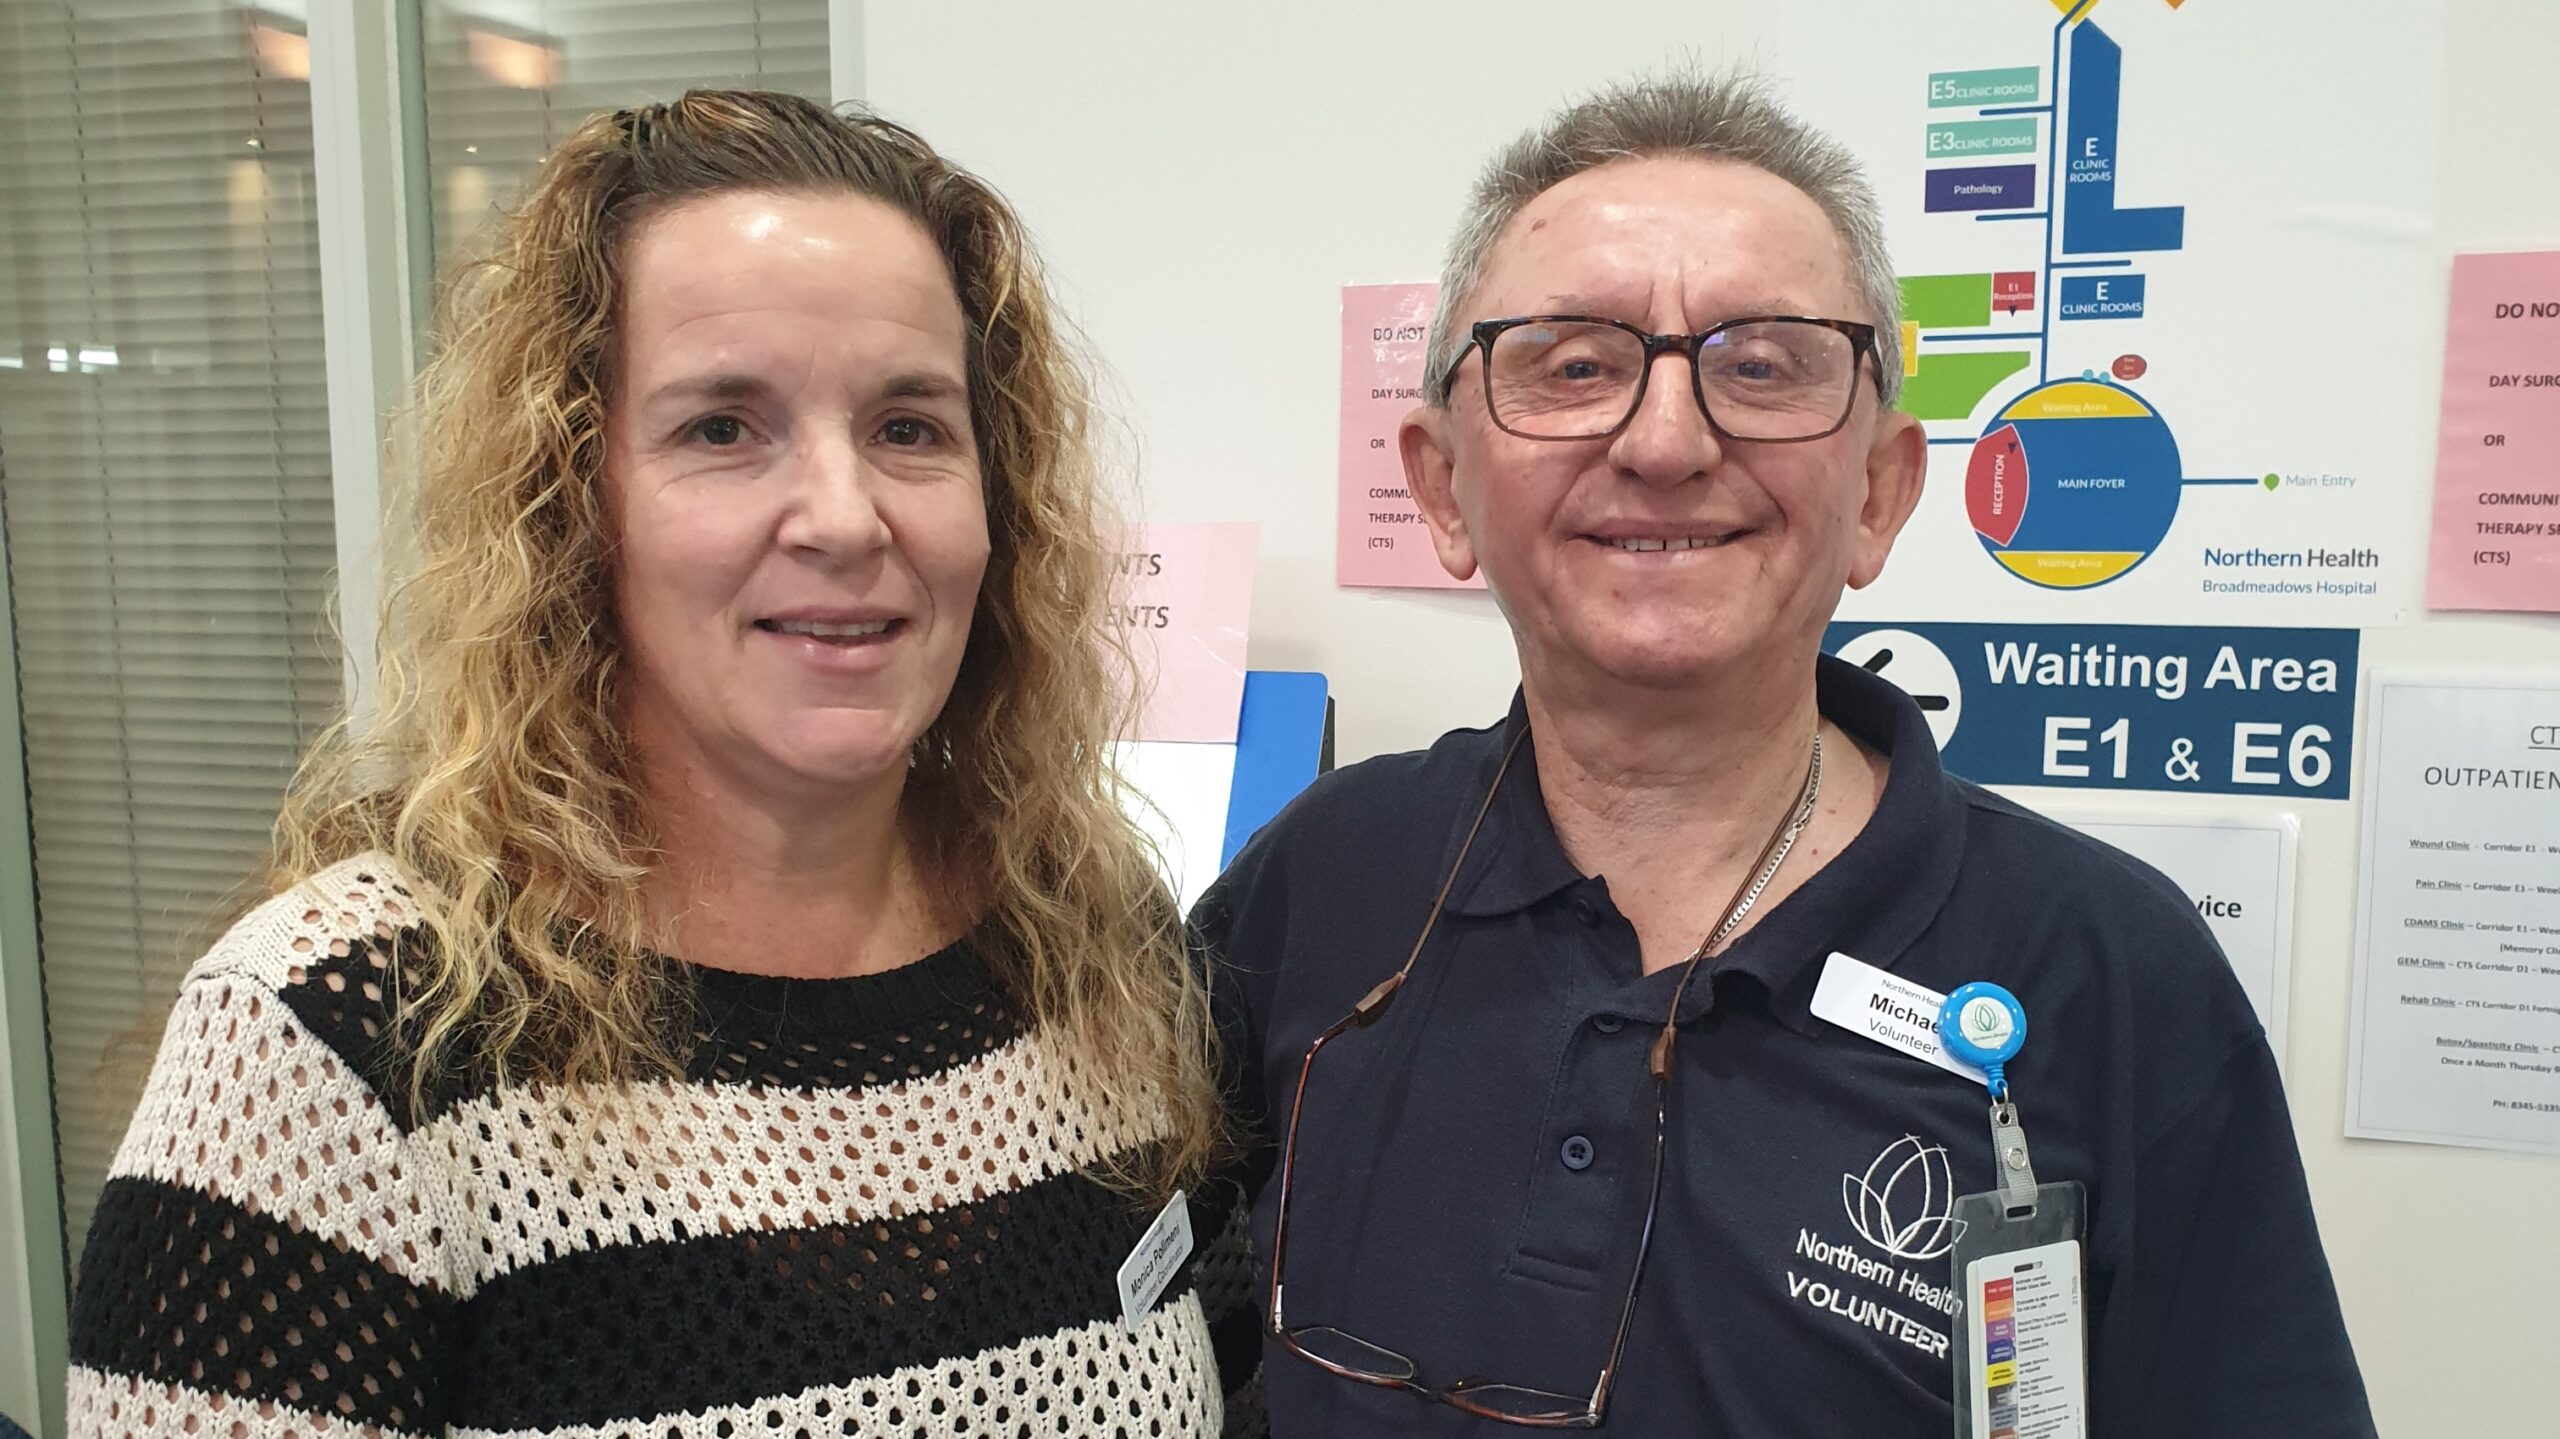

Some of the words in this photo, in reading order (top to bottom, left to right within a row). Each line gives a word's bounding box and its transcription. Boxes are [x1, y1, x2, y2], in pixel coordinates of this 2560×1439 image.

[1930, 79, 1956, 100] E5
[1956, 86, 1992, 99] CLINIC
[1993, 83, 2036, 97] ROOMS
[1929, 131, 1955, 152] E3
[1955, 137, 1990, 150] CLINIC
[1992, 135, 2033, 148] ROOMS
[2085, 137, 2099, 157] E
[2072, 158, 2110, 170] CLINIC
[2069, 171, 2112, 183] ROOMS
[1953, 183, 2004, 196] Pathology
[2096, 281, 2110, 300] E
[2061, 303, 2098, 314] CLINIC
[2100, 302, 2143, 313] ROOMS
[2495, 303, 2525, 319] DO
[2530, 302, 2560, 318] NO
[1373, 327, 1393, 341] DO
[1396, 327, 1426, 341] NOT
[2489, 374, 2521, 388] DAY
[1371, 388, 1393, 399] DAY
[1370, 438, 1386, 449] OR
[2483, 434, 2505, 447] OR
[1993, 453, 2006, 516] RECEPTION
[2057, 479, 2089, 489] MAIN
[2089, 479, 2126, 489] FOYER
[2285, 474, 2318, 487] Main
[2322, 474, 2357, 488] Entry
[2478, 492, 2560, 506] COMMUNI
[1368, 512, 1416, 524] THERAPY
[2476, 522, 2544, 535] THERAPY
[1367, 536, 1394, 550] (CTS)
[2204, 547, 2303, 567] Northern
[2306, 548, 2379, 568] Health
[2473, 549, 2511, 566] (CTS)
[2202, 579, 2313, 594] Broadmeadows
[2316, 580, 2377, 596] Hospital
[1983, 641, 2189, 700] Waiting
[2202, 645, 2338, 693] Area
[2042, 716, 2131, 780] E1
[2164, 737, 2201, 783] &
[2230, 721, 2333, 788] E6
[2409, 838, 2444, 850] Wound
[2445, 840, 2470, 851] Clinic
[2483, 842, 2523, 853] Corridor
[2415, 879, 2436, 889] Pain
[2438, 880, 2463, 891] Clinic
[2473, 881, 2512, 892] Corridor
[2403, 918, 2439, 929] CDAMS
[2440, 919, 2465, 931] Clinic
[2475, 922, 2514, 932] Corridor
[2397, 956, 2420, 968] GEM
[2421, 958, 2446, 970] Clinic
[2456, 960, 2473, 970] CTS
[2475, 962, 2514, 972] Corridor
[1881, 978, 1922, 1000] Northern
[2400, 994, 2430, 1005] Rehab
[2431, 996, 2456, 1008] Clinic
[1869, 1017, 1939, 1056] Volunteer
[2513, 1042, 2539, 1054] Clinic
[2440, 1056, 2465, 1066] Once
[2474, 1058, 2507, 1069] Month
[2508, 1061, 2552, 1074] Thursday
[1795, 1227, 1895, 1288] Northern
[1897, 1268, 1963, 1319] Health
[1786, 1270, 1950, 1360] VOLUNTEER
